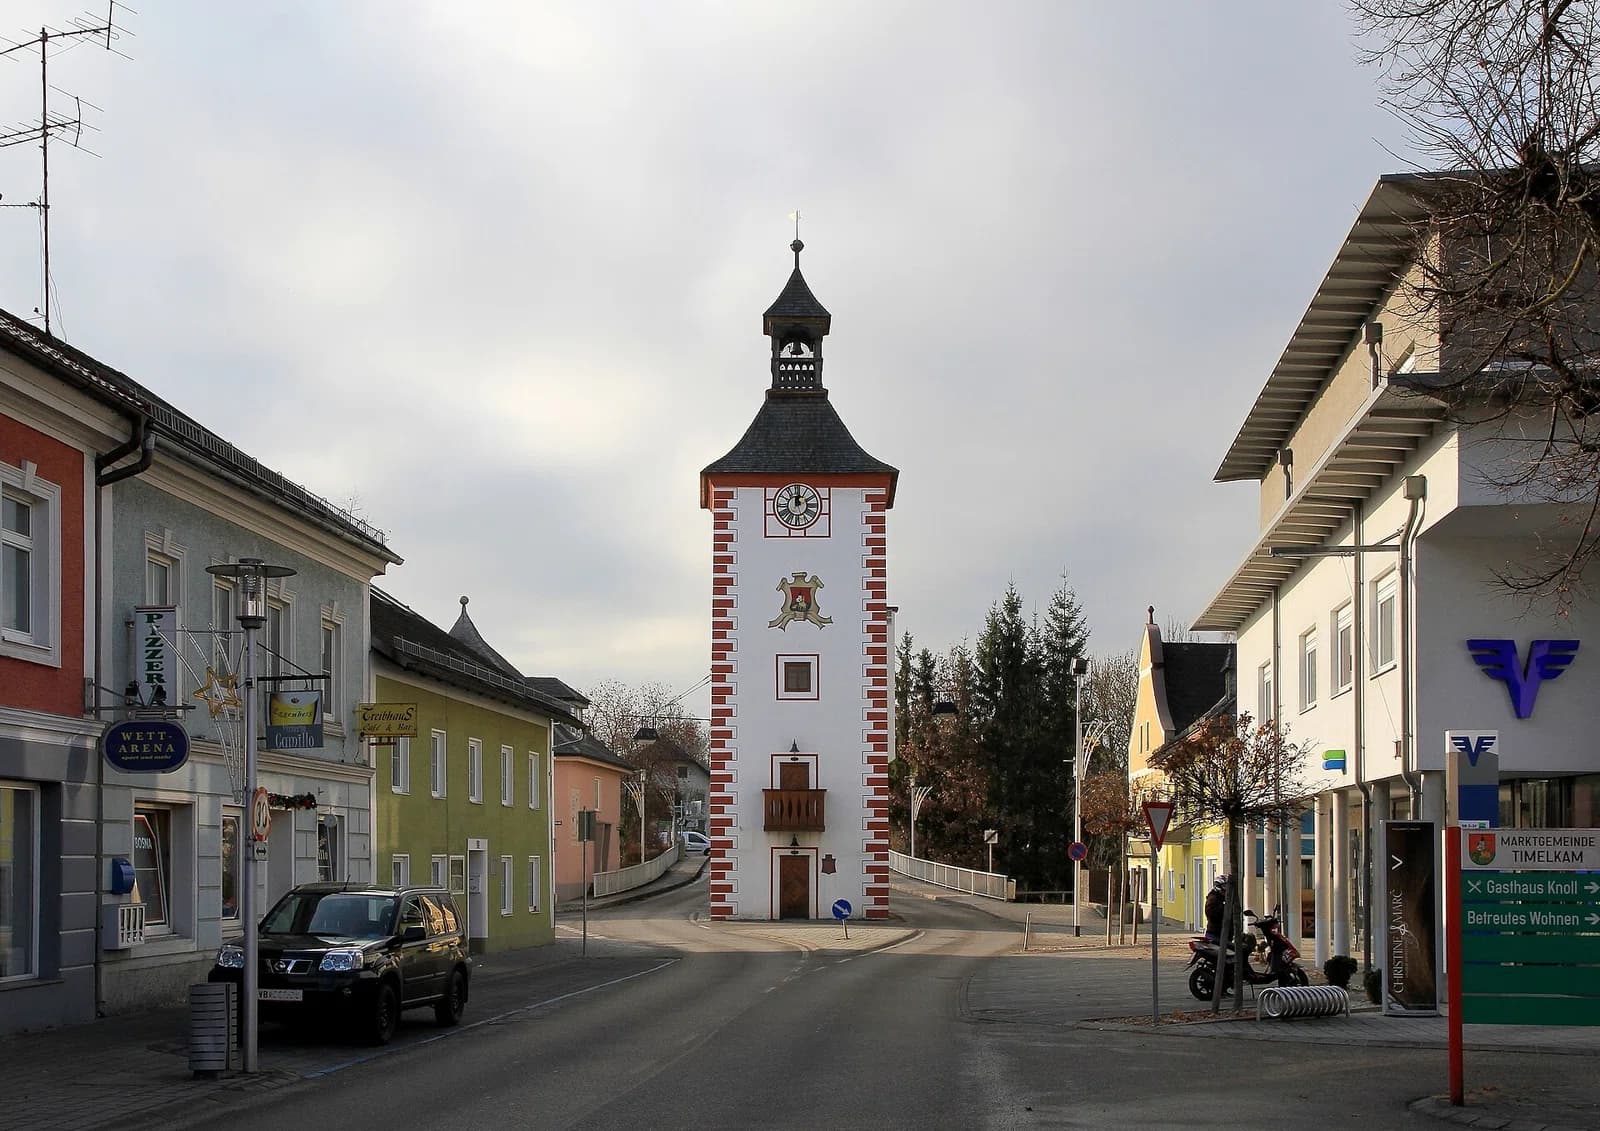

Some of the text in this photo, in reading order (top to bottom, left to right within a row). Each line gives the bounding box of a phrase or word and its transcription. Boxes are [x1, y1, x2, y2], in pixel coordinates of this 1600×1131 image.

[121, 731, 173, 741] WETT-
[275, 732, 315, 748] Camillo
[119, 743, 175, 753] ARENA
[256, 801, 268, 828] 30
[1500, 836, 1596, 847] MARKTGEMEINDE
[1512, 850, 1584, 863] TIMELKAM
[1486, 880, 1578, 895] Gasthaus Knoll
[1467, 910, 1580, 926] Betreutes Wohnen
[1392, 934, 1404, 994] CHRISTINE
